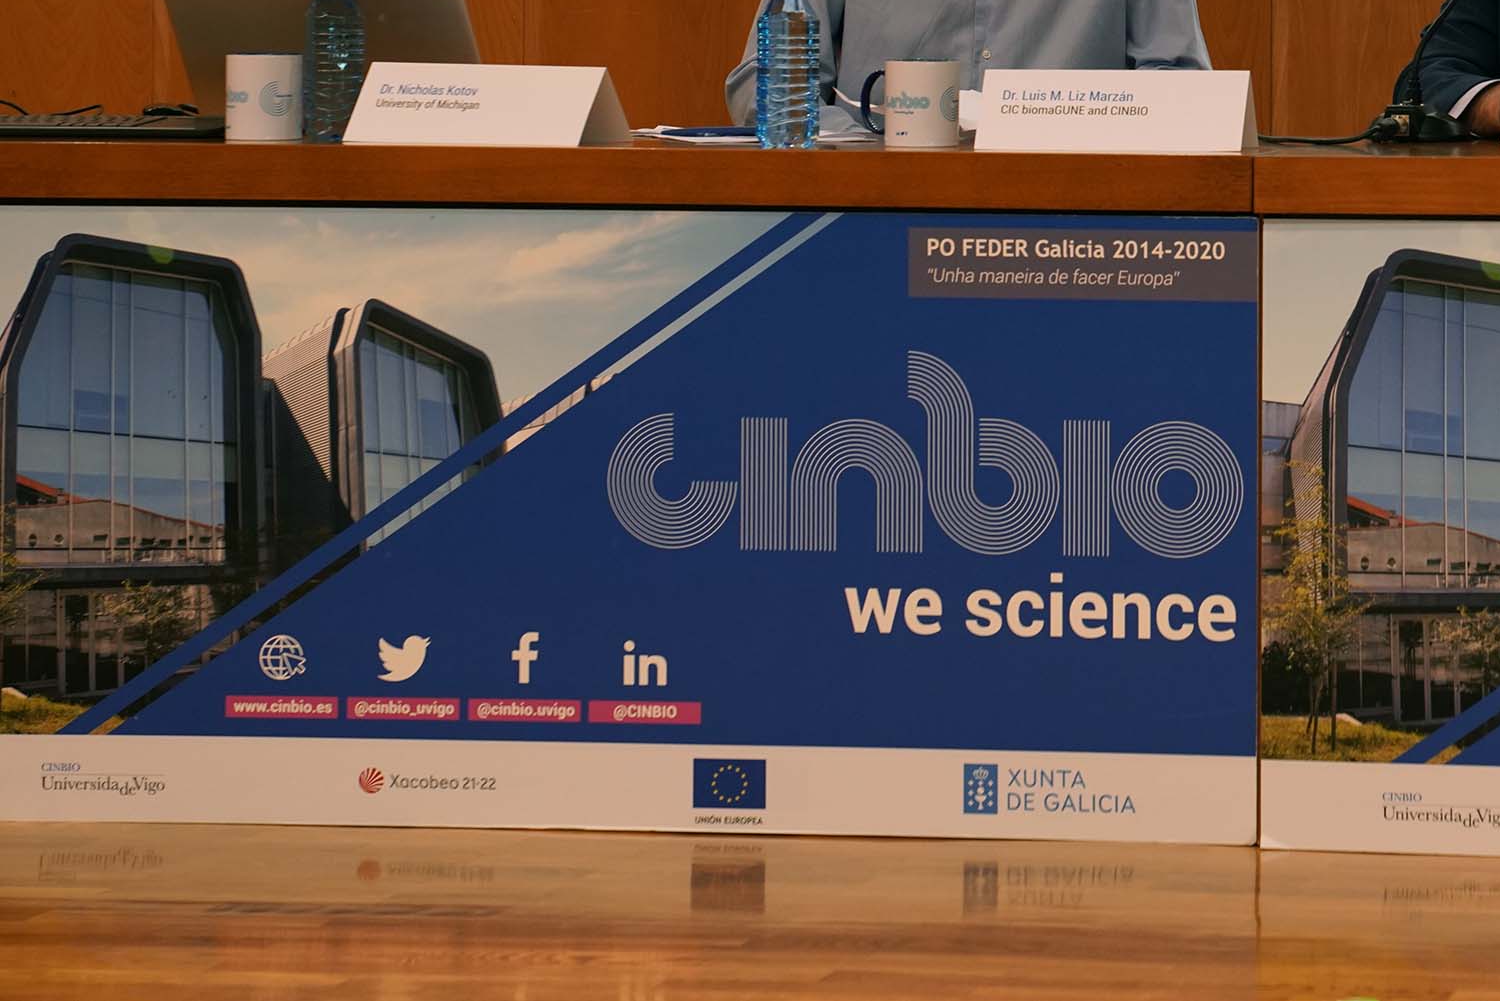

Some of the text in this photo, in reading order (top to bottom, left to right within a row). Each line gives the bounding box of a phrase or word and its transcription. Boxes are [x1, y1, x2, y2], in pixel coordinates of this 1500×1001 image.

[380, 84, 478, 96] Dr. Nicholas Kotov
[1002, 90, 1134, 102] Dr. Luis M. Liz Marzán
[376, 100, 480, 112] University of Michigan
[1000, 105, 1148, 116] CIC biomaGUNE and CINBIO
[926, 238, 1226, 260] PO FEDER Galicia 2014-2020
[979, 267, 1044, 285] maneira
[1049, 267, 1068, 285] de
[1072, 267, 1113, 286] facer
[844, 572, 1237, 642] we science
[233, 699, 333, 715] www.cinbio.es
[354, 700, 454, 718] @cinbio_uvigo
[477, 702, 575, 720] @cinbio.uvigo
[613, 703, 677, 720] @CINBIO
[41, 762, 81, 772] CINBIO
[389, 774, 459, 790] Xacobeo
[1007, 768, 1085, 789] XUNTA
[1007, 792, 1136, 814] DE GALICIA
[1382, 792, 1422, 802] CINBIO
[694, 814, 763, 826] UNIÓN EUROPEA
